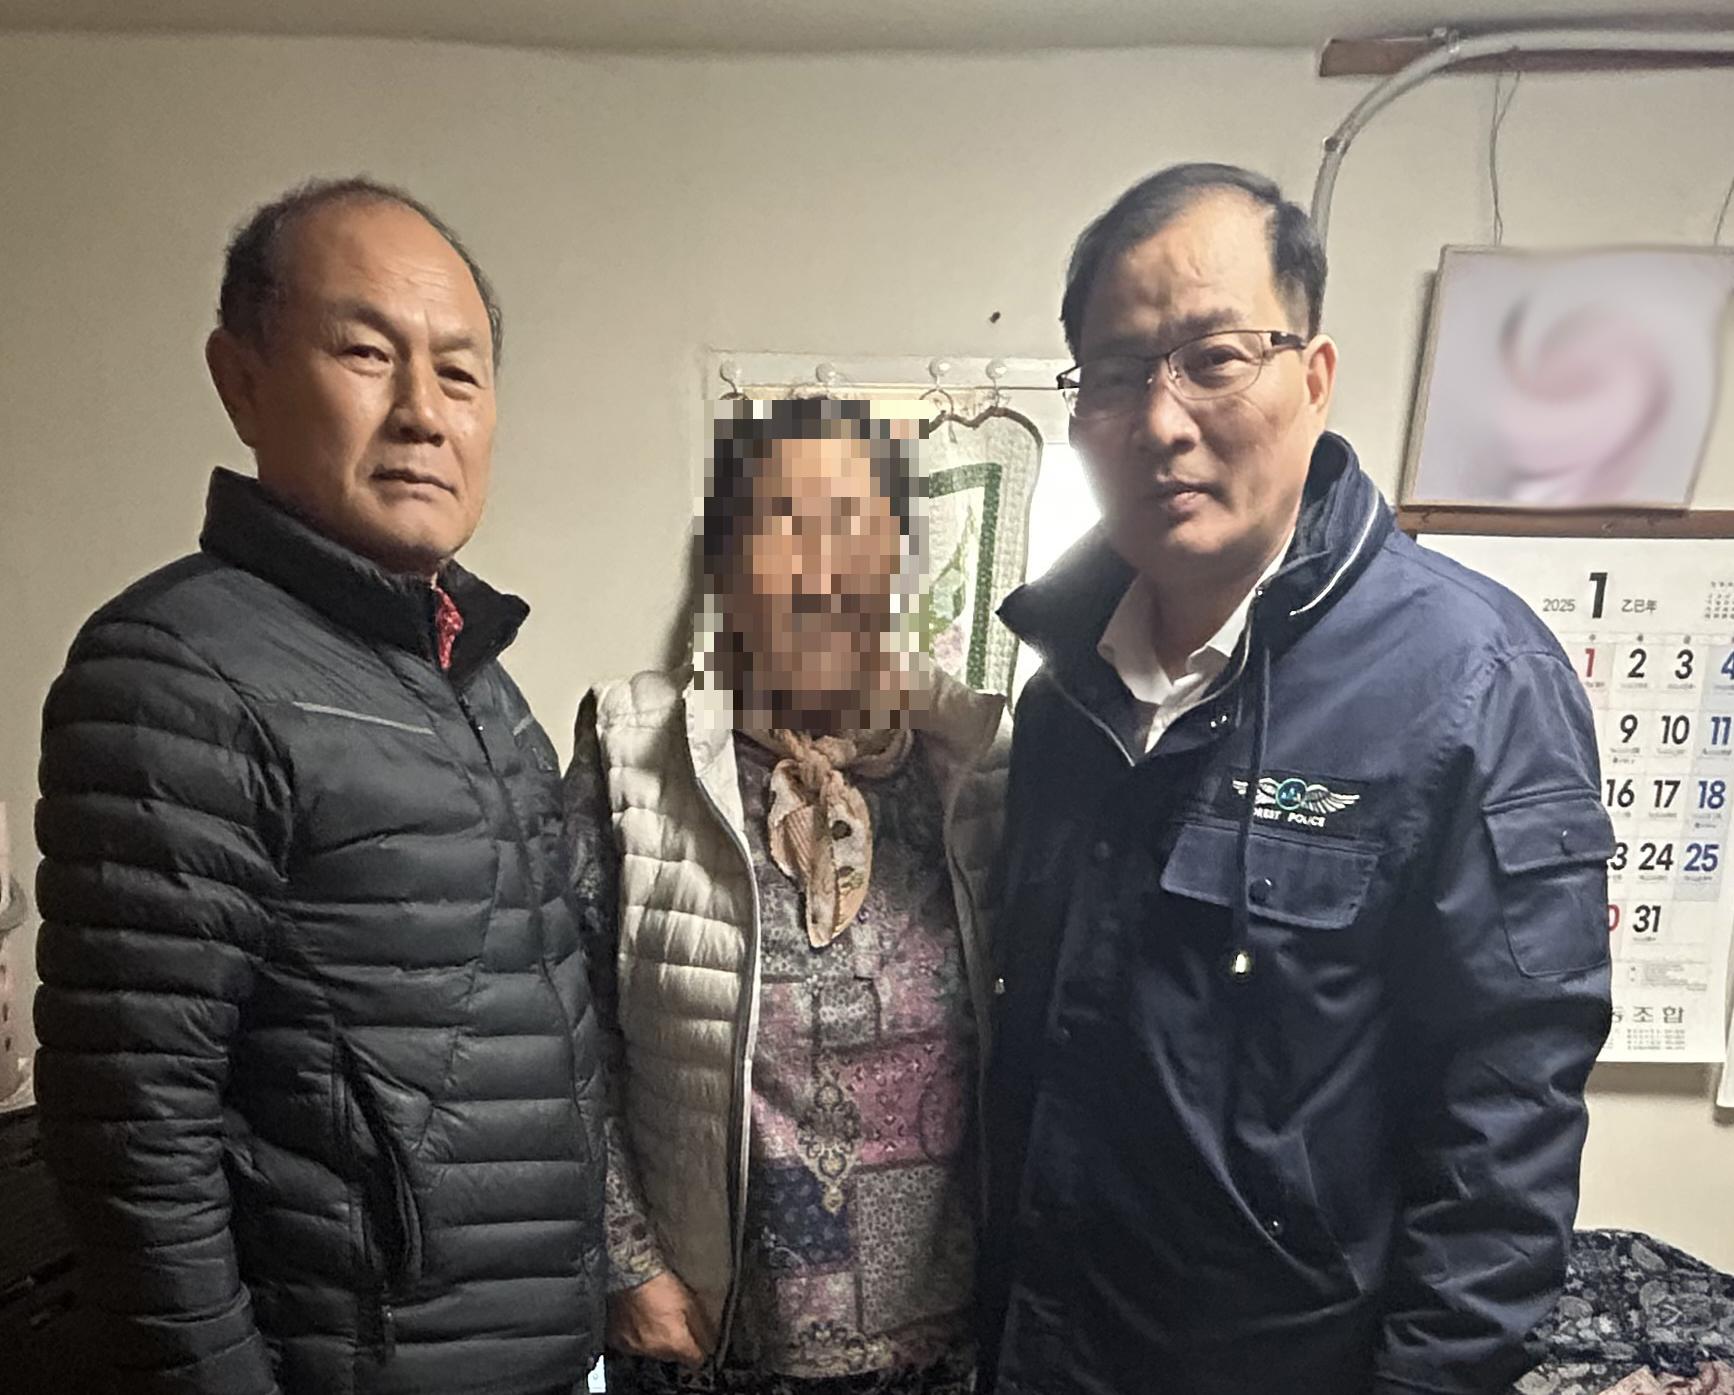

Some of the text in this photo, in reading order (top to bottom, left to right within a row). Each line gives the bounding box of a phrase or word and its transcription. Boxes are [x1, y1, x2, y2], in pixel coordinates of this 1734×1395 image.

[1543, 572, 1608, 619] 2025 1
[1585, 648, 1595, 679] 1
[1627, 648, 1647, 679] 2
[1674, 649, 1694, 680] 3
[1620, 714, 1732, 745] 9 10 11
[1606, 779, 1726, 810] 16 17 18
[1287, 812, 1326, 828] POLICE
[1610, 842, 1719, 872] 3 24 25
[1632, 905, 1662, 933] 31
